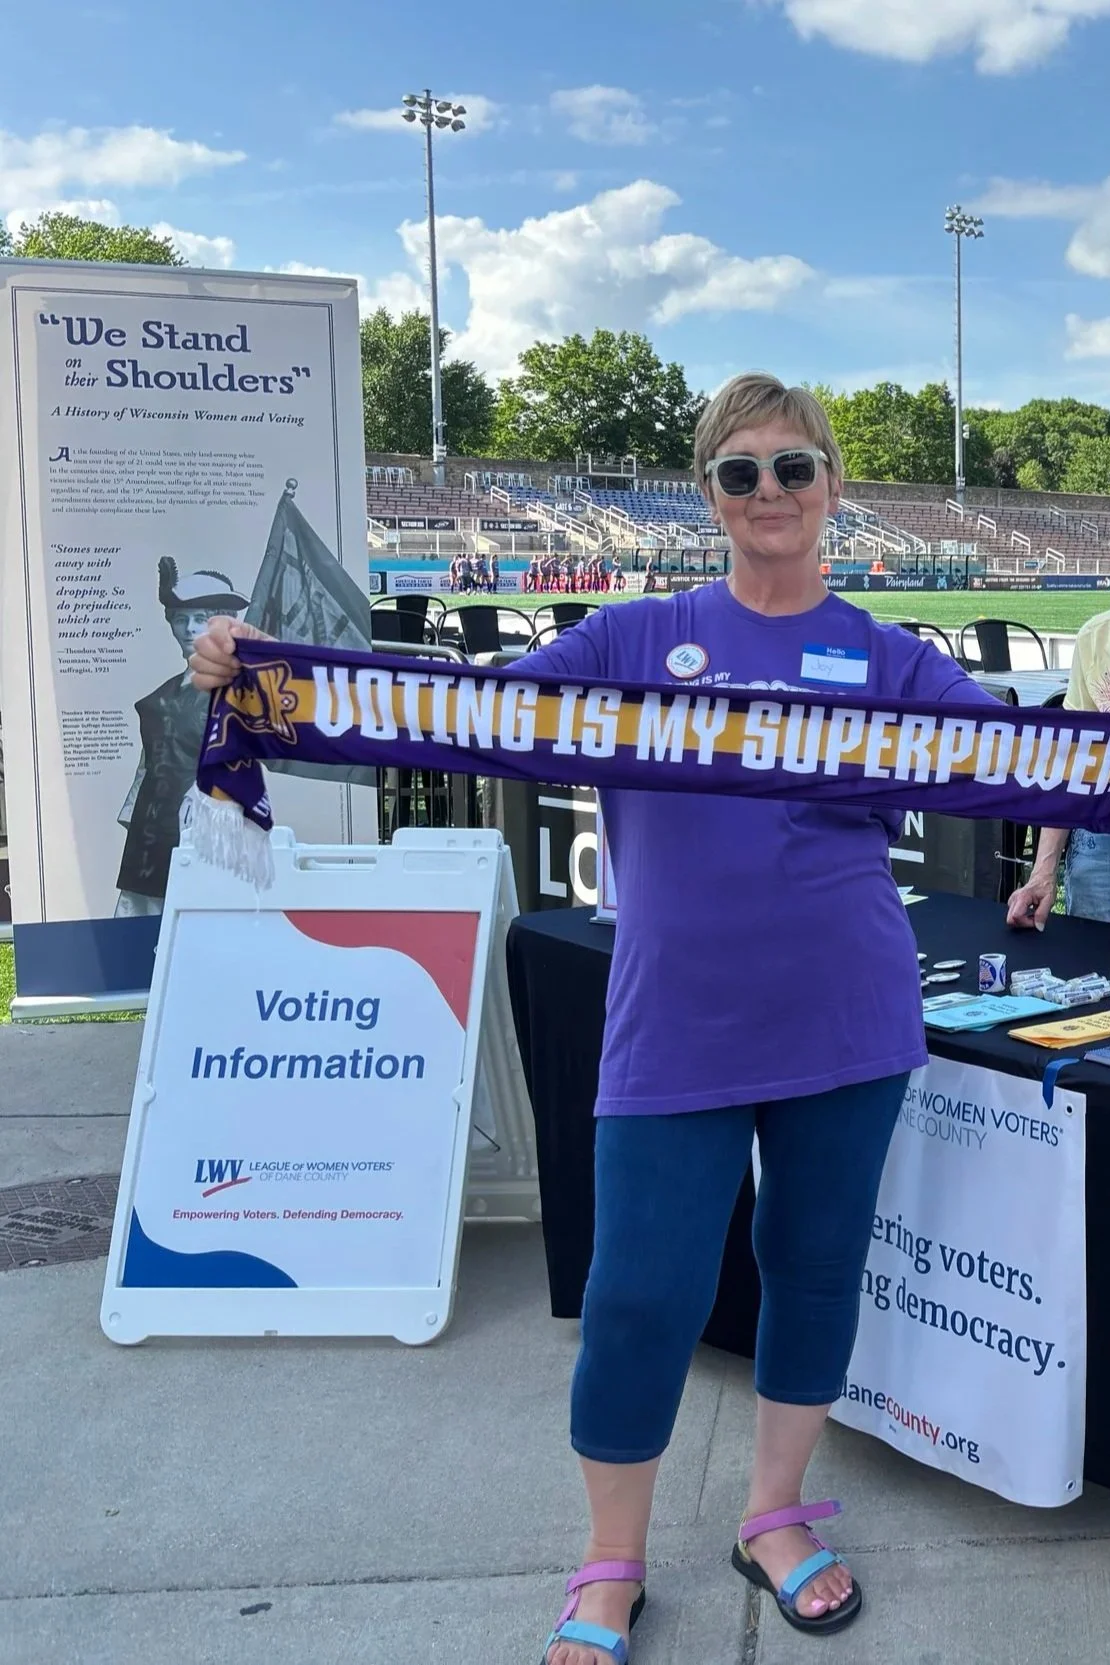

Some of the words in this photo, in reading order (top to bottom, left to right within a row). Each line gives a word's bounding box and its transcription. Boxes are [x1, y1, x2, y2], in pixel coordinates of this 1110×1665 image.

[142, 319, 252, 353] Stand
[65, 357, 82, 369] on
[64, 371, 99, 388] their
[106, 358, 311, 394] Shoulders”
[51, 406, 62, 417] A
[65, 406, 110, 421] History
[113, 406, 128, 421] of
[129, 407, 189, 421] Wisconsin
[194, 410, 238, 422] Women
[240, 411, 265, 423] and
[268, 411, 305, 426] Voting
[94, 546, 121, 554] wear
[54, 559, 84, 570] away
[87, 558, 112, 568] with
[56, 574, 102, 582] constant
[884, 576, 926, 590] Dairyland
[56, 586, 108, 599] dropping.
[112, 586, 125, 596] So
[57, 600, 70, 610] do
[73, 600, 132, 613] prejudices,
[58, 614, 90, 625] which
[58, 628, 88, 639] much
[826, 647, 846, 656] Hello
[702, 674, 713, 686] IS
[714, 672, 731, 683] MY
[312, 665, 541, 753] VOTING
[551, 684, 623, 759] IS
[635, 691, 730, 766] MY
[256, 989, 381, 1031] Voting
[191, 1047, 426, 1080] Information
[918, 1087, 986, 1127] WOMEN
[916, 1112, 987, 1151] COUNTY
[194, 1158, 244, 1183] LWV
[249, 1161, 291, 1171] LEAGUE
[306, 1161, 350, 1171] WOMEN
[351, 1161, 394, 1171] VOTERS
[260, 1172, 273, 1182] OF
[275, 1172, 302, 1182] DANE
[304, 1172, 349, 1182] COUNTY
[172, 1209, 240, 1222] Empowering
[243, 1209, 280, 1220] Voters.
[282, 1209, 338, 1222] Defending
[340, 1209, 404, 1222] Democracy.
[871, 1213, 933, 1275] ering
[939, 1243, 1042, 1305] voters.
[896, 1276, 1066, 1377] democracy.
[841, 1374, 981, 1465] anecounty.org
